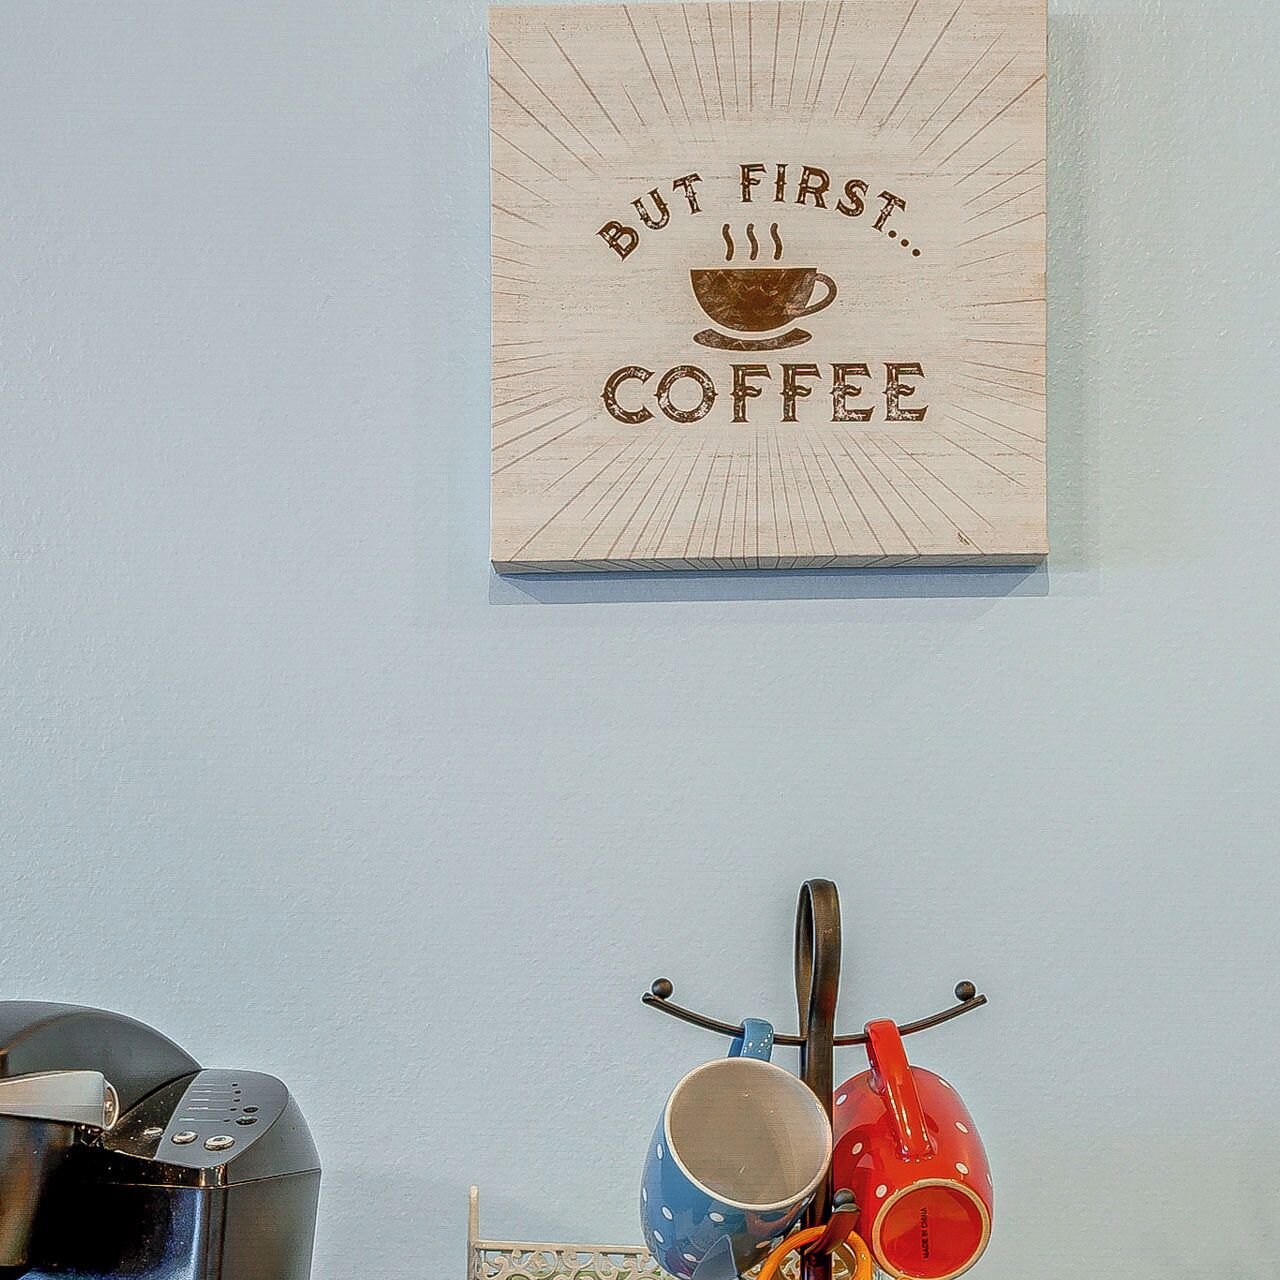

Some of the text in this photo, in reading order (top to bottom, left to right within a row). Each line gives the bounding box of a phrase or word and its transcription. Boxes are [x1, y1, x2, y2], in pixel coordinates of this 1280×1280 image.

[596, 163, 922, 261] BUT FIRST...
[600, 362, 929, 424] COFFEE
[920, 1207, 928, 1229] CHINA
[921, 1237, 929, 1259] MADE
